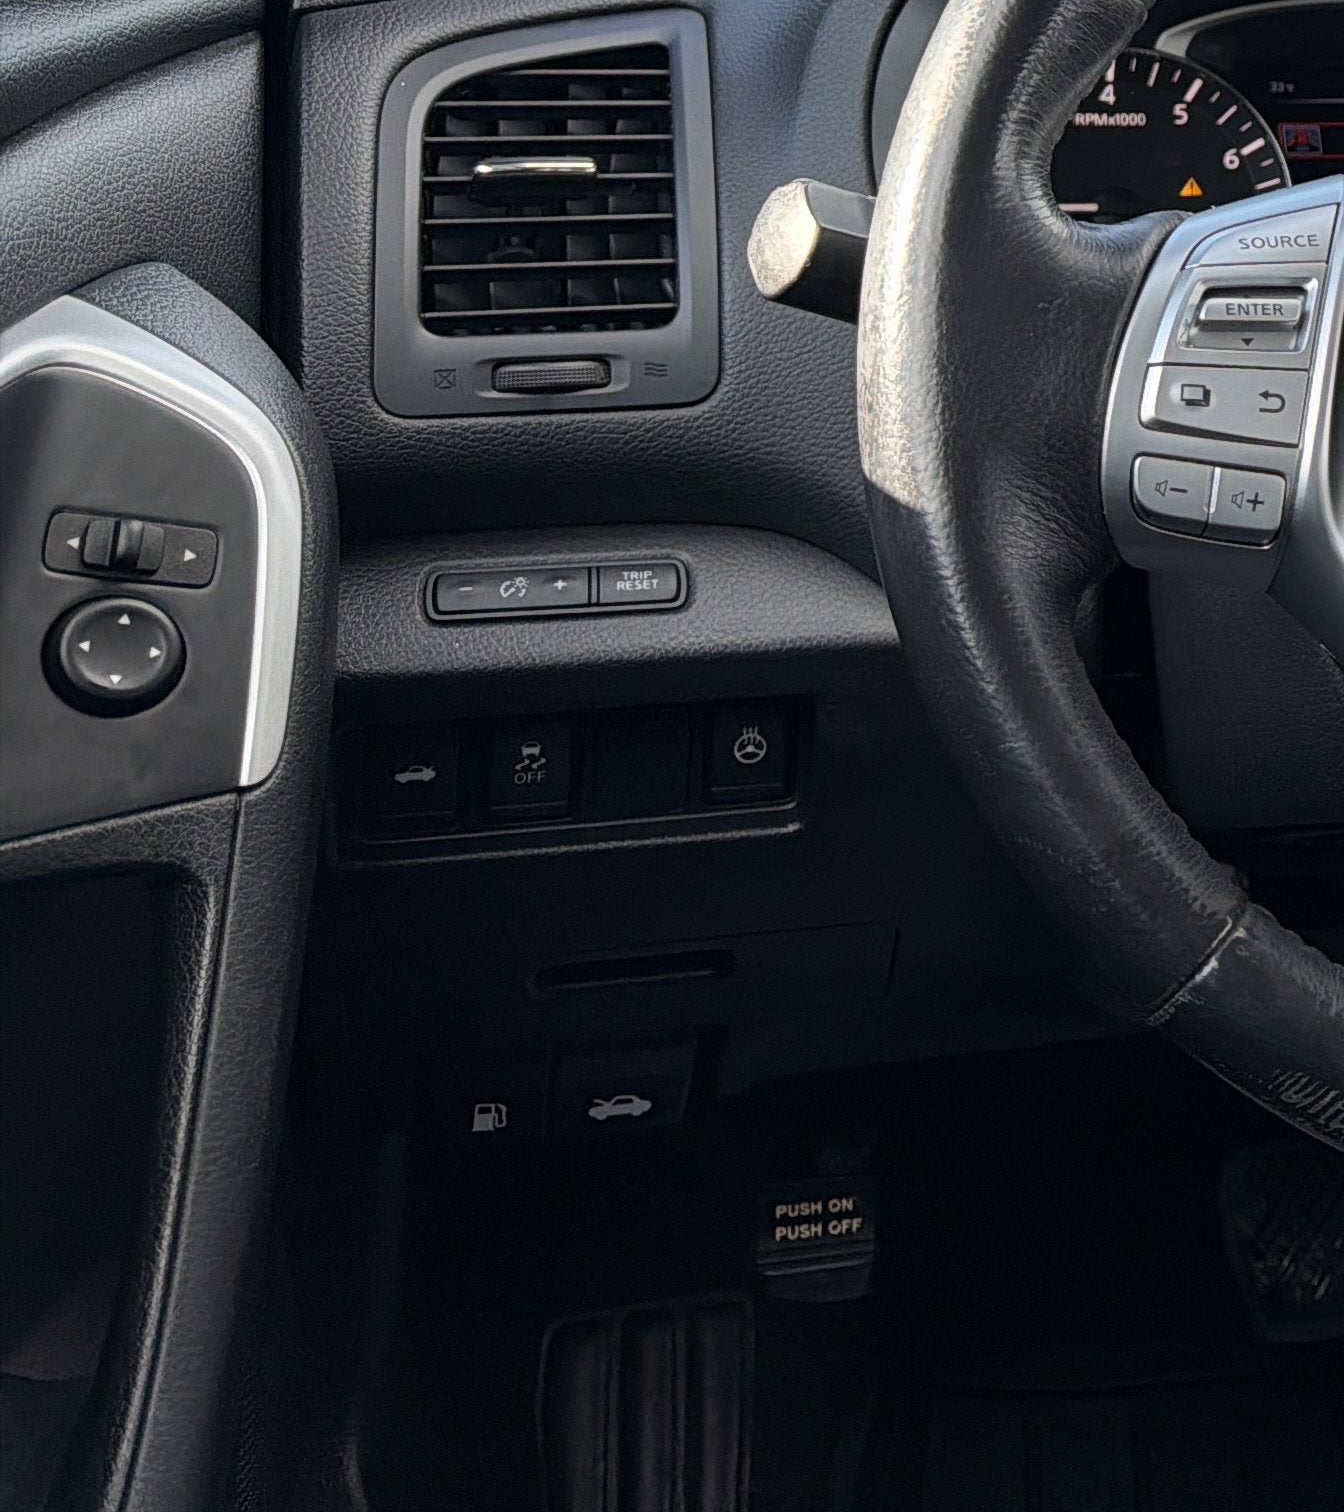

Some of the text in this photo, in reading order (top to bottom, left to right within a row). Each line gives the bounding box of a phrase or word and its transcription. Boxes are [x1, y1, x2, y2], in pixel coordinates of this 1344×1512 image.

[1100, 83, 1117, 106] 4
[1172, 103, 1189, 125] 5
[1222, 147, 1240, 170] 6
[1238, 233, 1319, 251] SOURCE
[1225, 302, 1285, 318] ENTER
[616, 578, 659, 591] RESET
[622, 570, 653, 581] TRIP
[514, 770, 546, 785] OFF
[775, 1197, 854, 1220] PUSH ON
[775, 1217, 863, 1242] PUSH OFF
